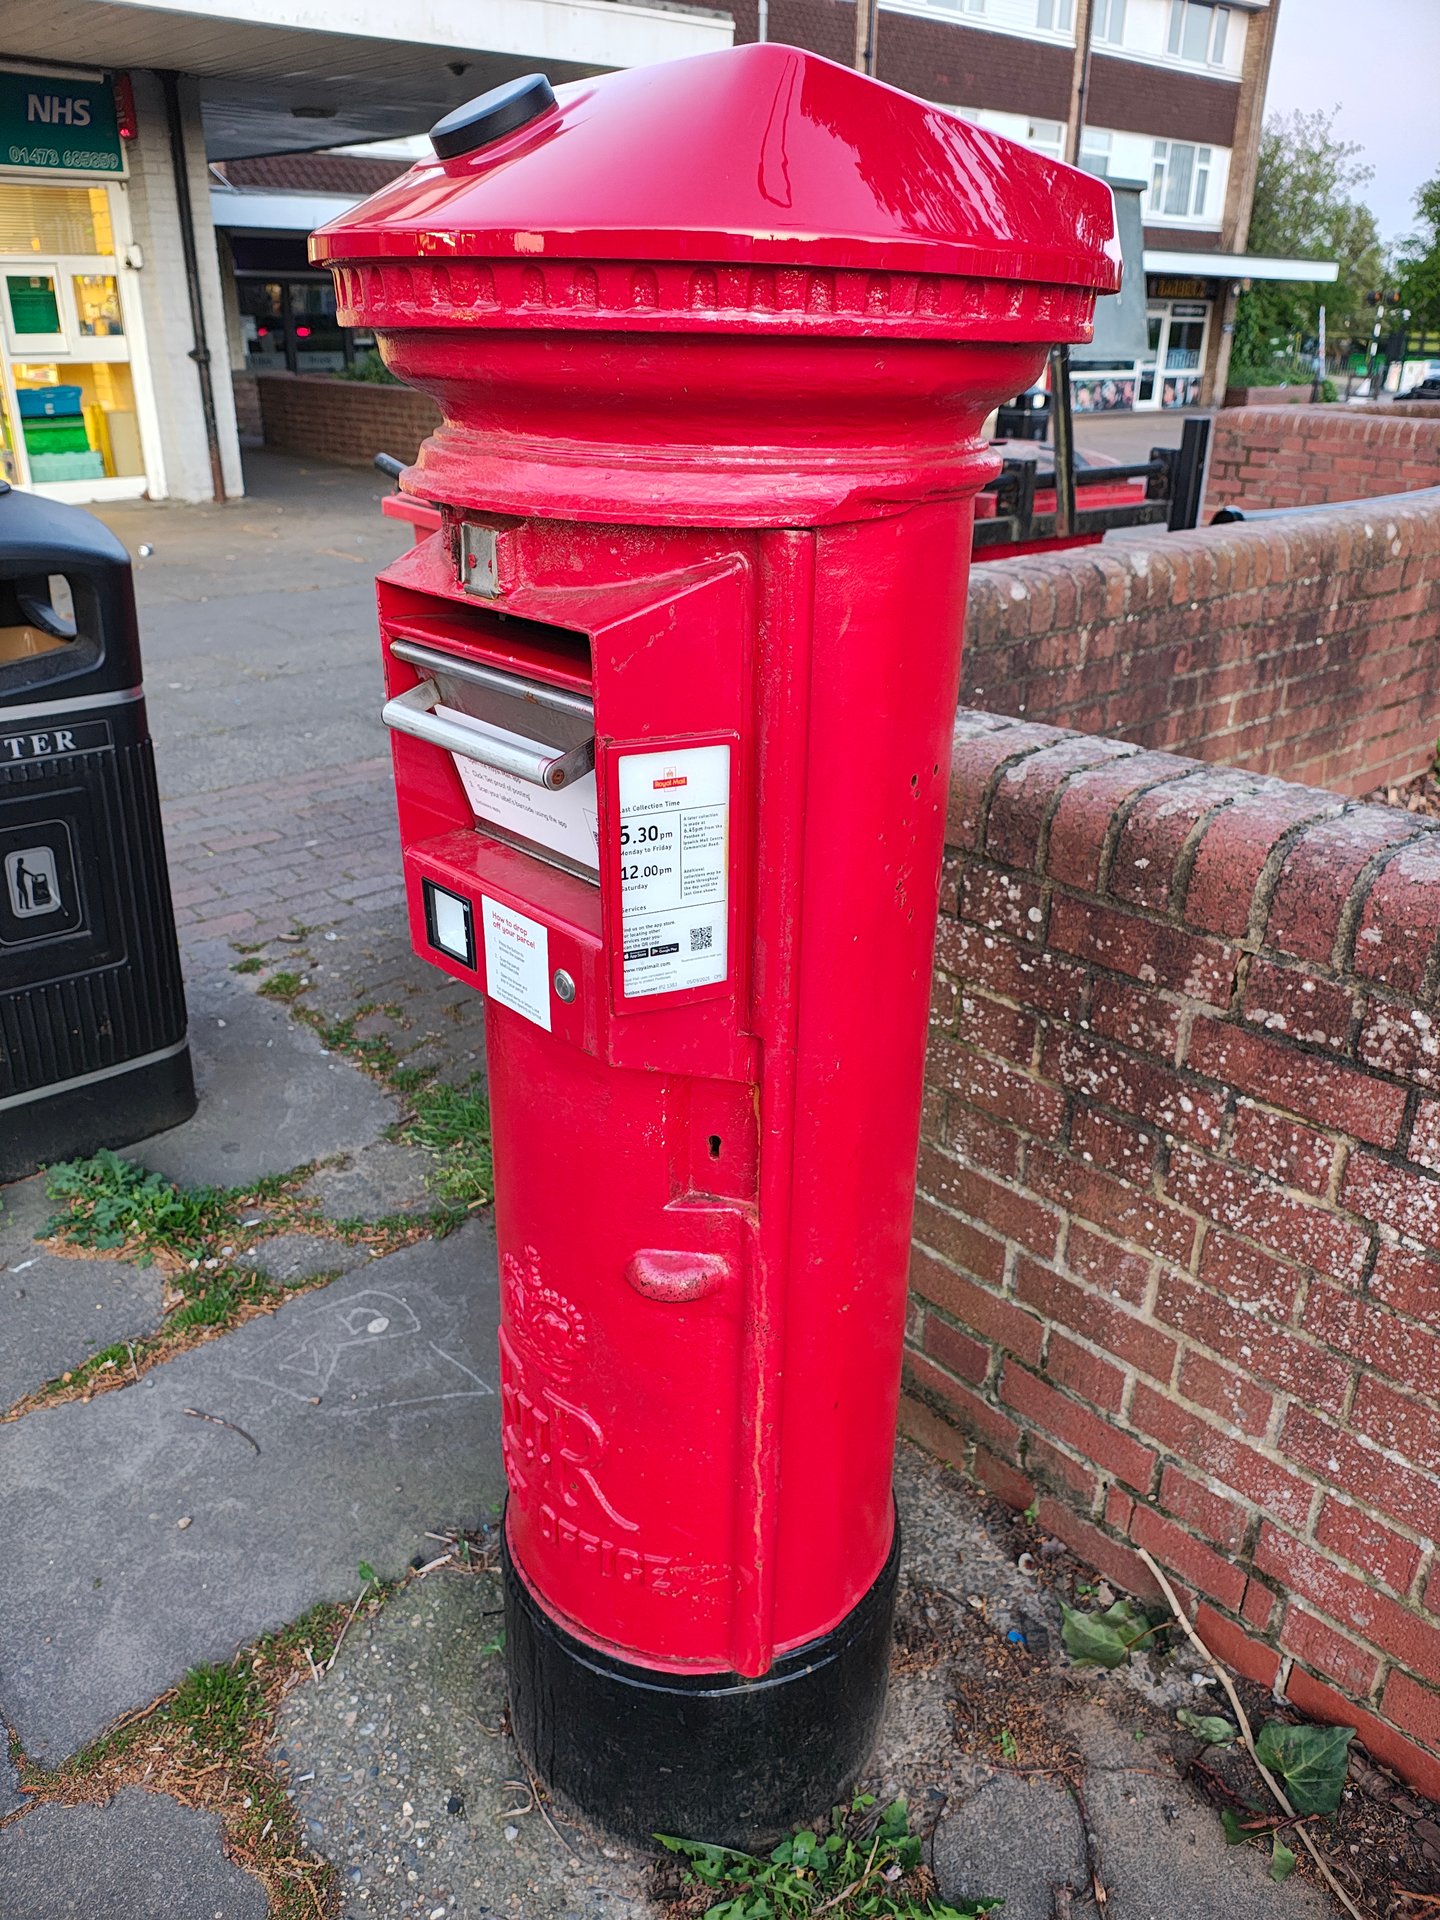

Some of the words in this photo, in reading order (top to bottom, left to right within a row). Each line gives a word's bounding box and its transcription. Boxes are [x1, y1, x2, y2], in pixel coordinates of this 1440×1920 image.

[27, 93, 91, 127] NHS
[8, 145, 60, 166] 01473
[654, 779, 672, 789] Royal
[672, 777, 686, 786] Mail
[632, 801, 664, 812] Collection
[664, 800, 680, 808] Time
[652, 844, 673, 852] Friday
[621, 865, 672, 881] 12.00pm
[491, 909, 506, 924] How
[505, 918, 513, 928] to
[512, 923, 528, 937] drop
[492, 920, 502, 931] off
[501, 925, 517, 937] your
[516, 933, 536, 950] parcel
